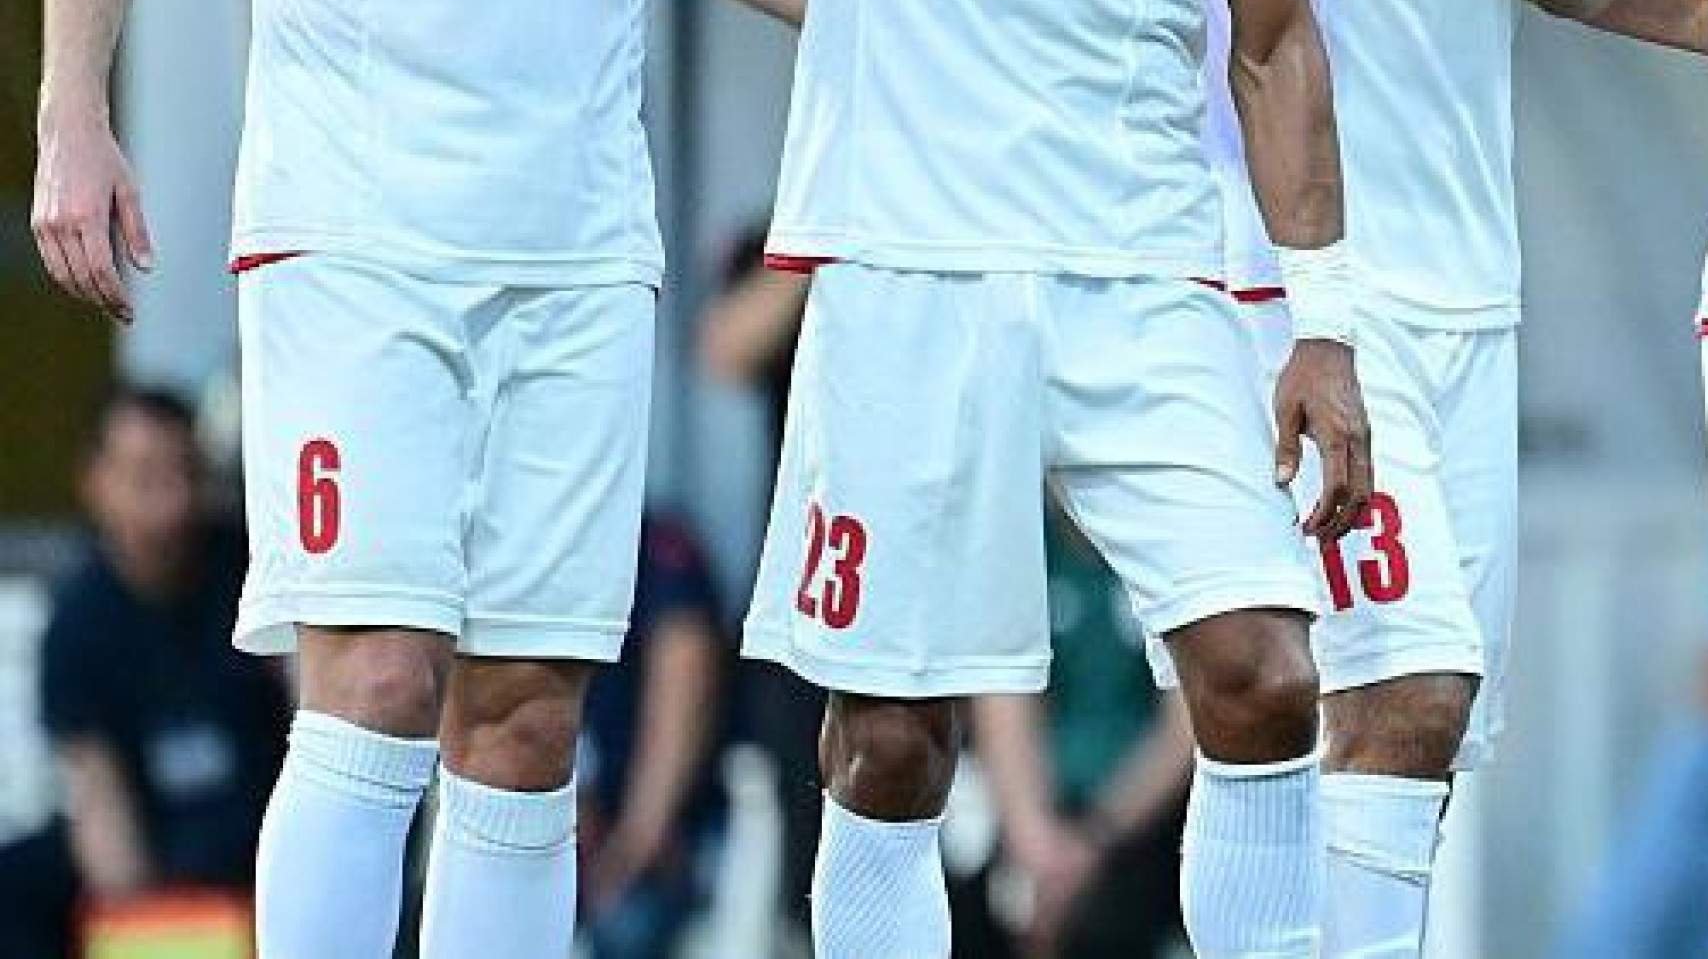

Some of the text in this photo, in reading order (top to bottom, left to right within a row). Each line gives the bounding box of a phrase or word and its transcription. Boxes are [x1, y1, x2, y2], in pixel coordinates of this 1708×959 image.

[296, 439, 343, 556] 6
[1316, 491, 1412, 612] 13
[797, 504, 868, 631] 23
